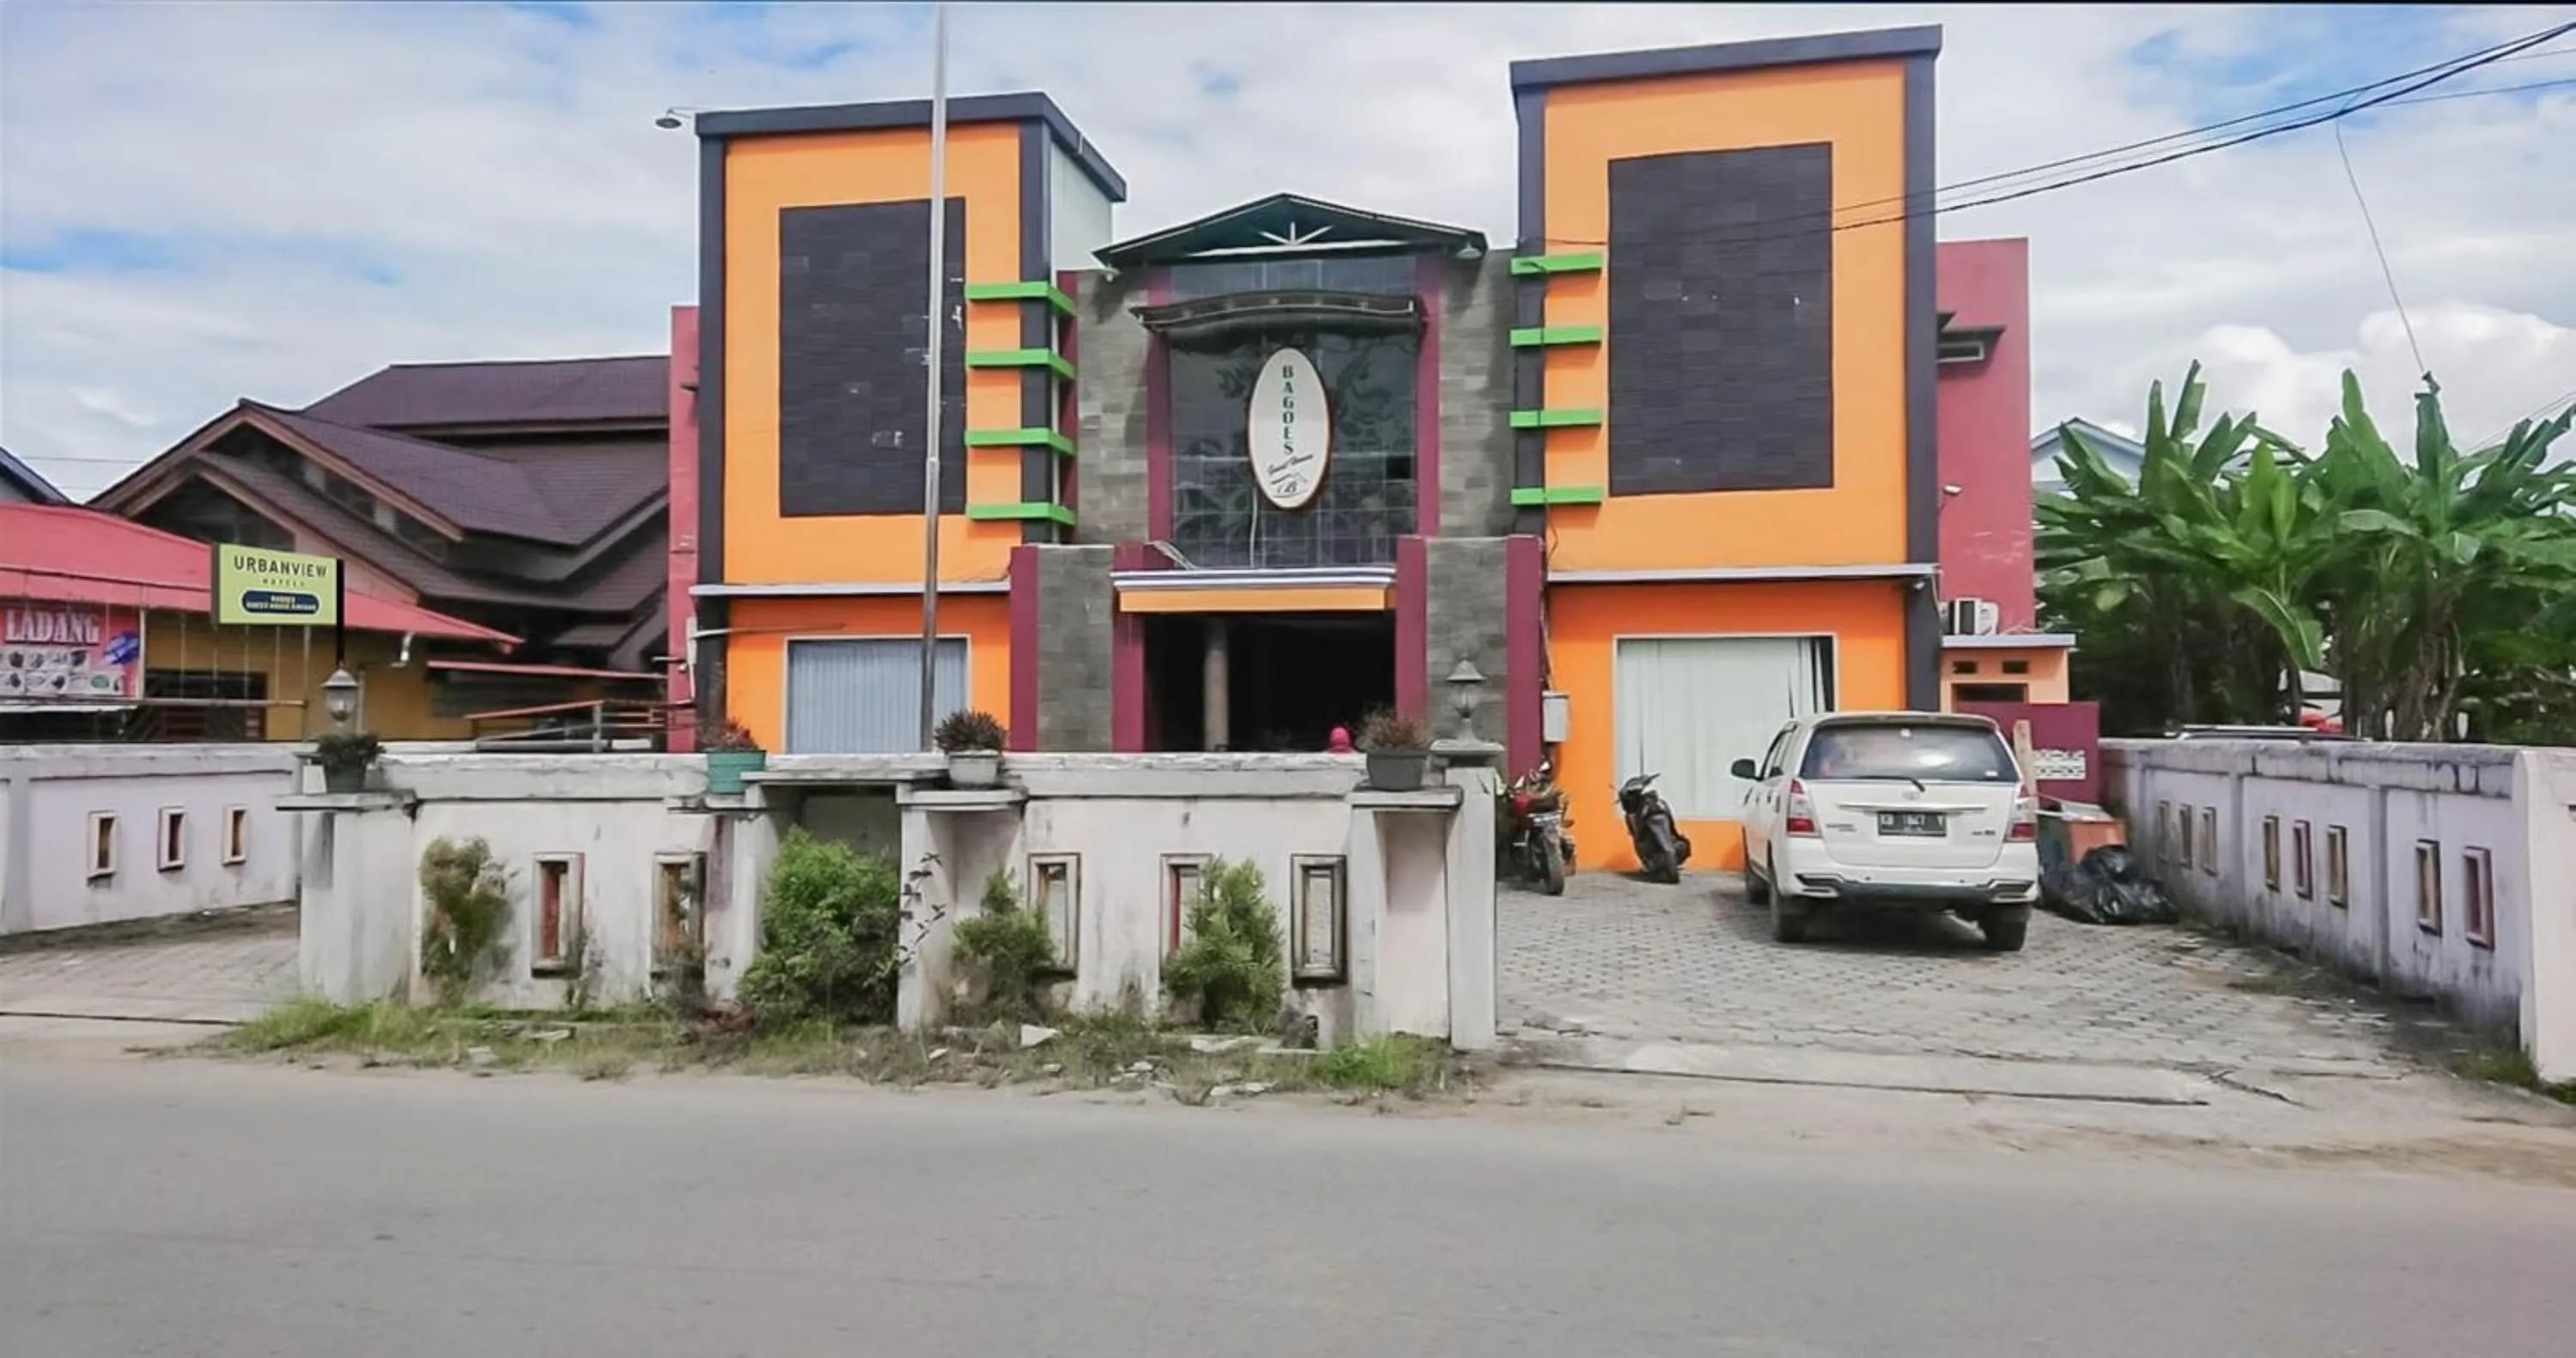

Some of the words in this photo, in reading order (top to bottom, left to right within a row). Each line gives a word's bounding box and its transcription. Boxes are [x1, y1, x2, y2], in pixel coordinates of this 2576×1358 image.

[1282, 365, 1294, 454] BAGOES
[234, 555, 327, 577] URBANVIEW
[5, 610, 100, 643] LADANG
